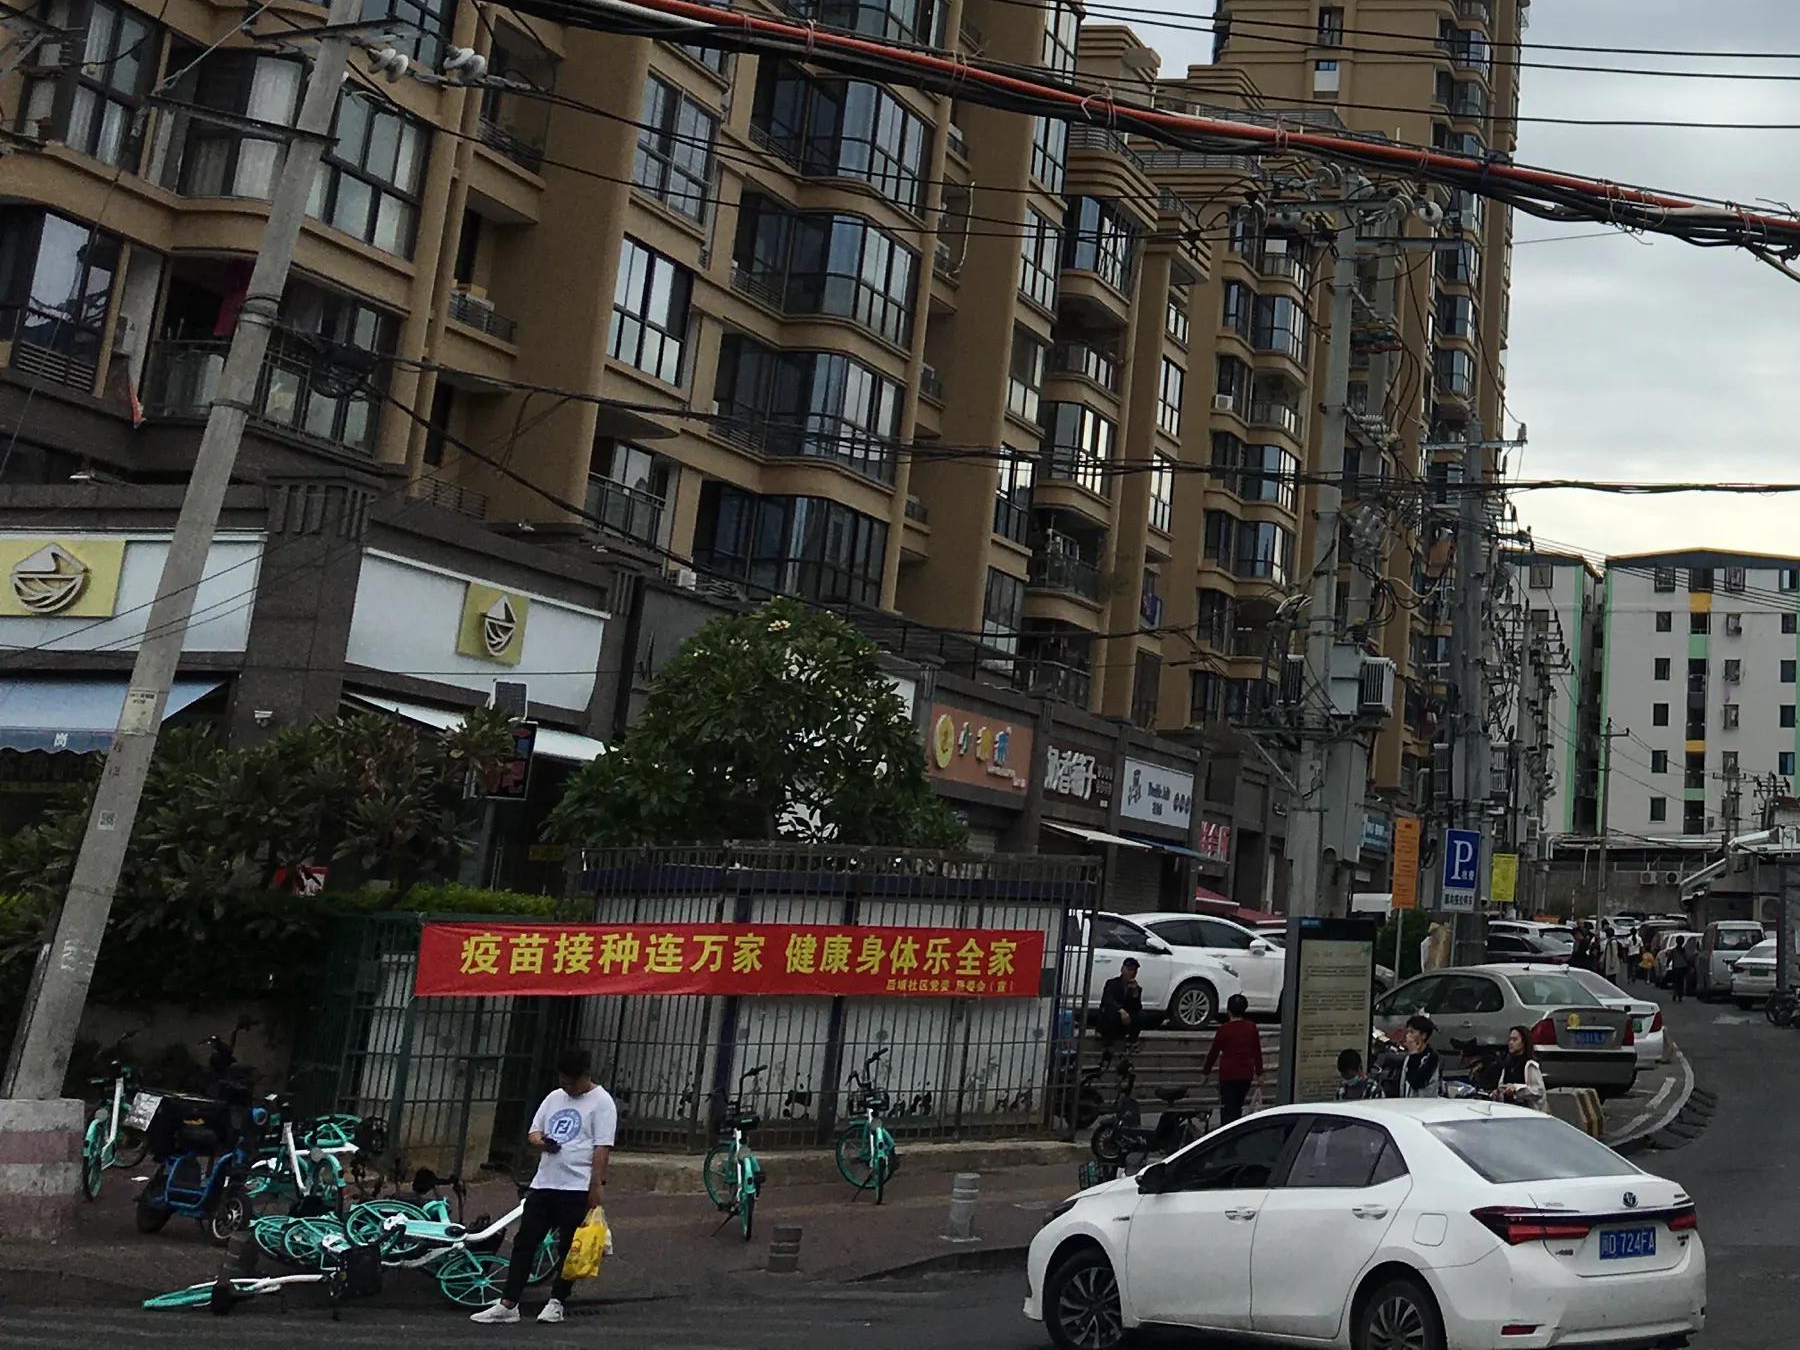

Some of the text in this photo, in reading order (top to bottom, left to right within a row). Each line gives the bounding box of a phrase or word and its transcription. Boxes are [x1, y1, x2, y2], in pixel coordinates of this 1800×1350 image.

[1450, 840, 1473, 880] P
[460, 932, 1017, 976] 疫苗接种连万家 健康身体乐全家
